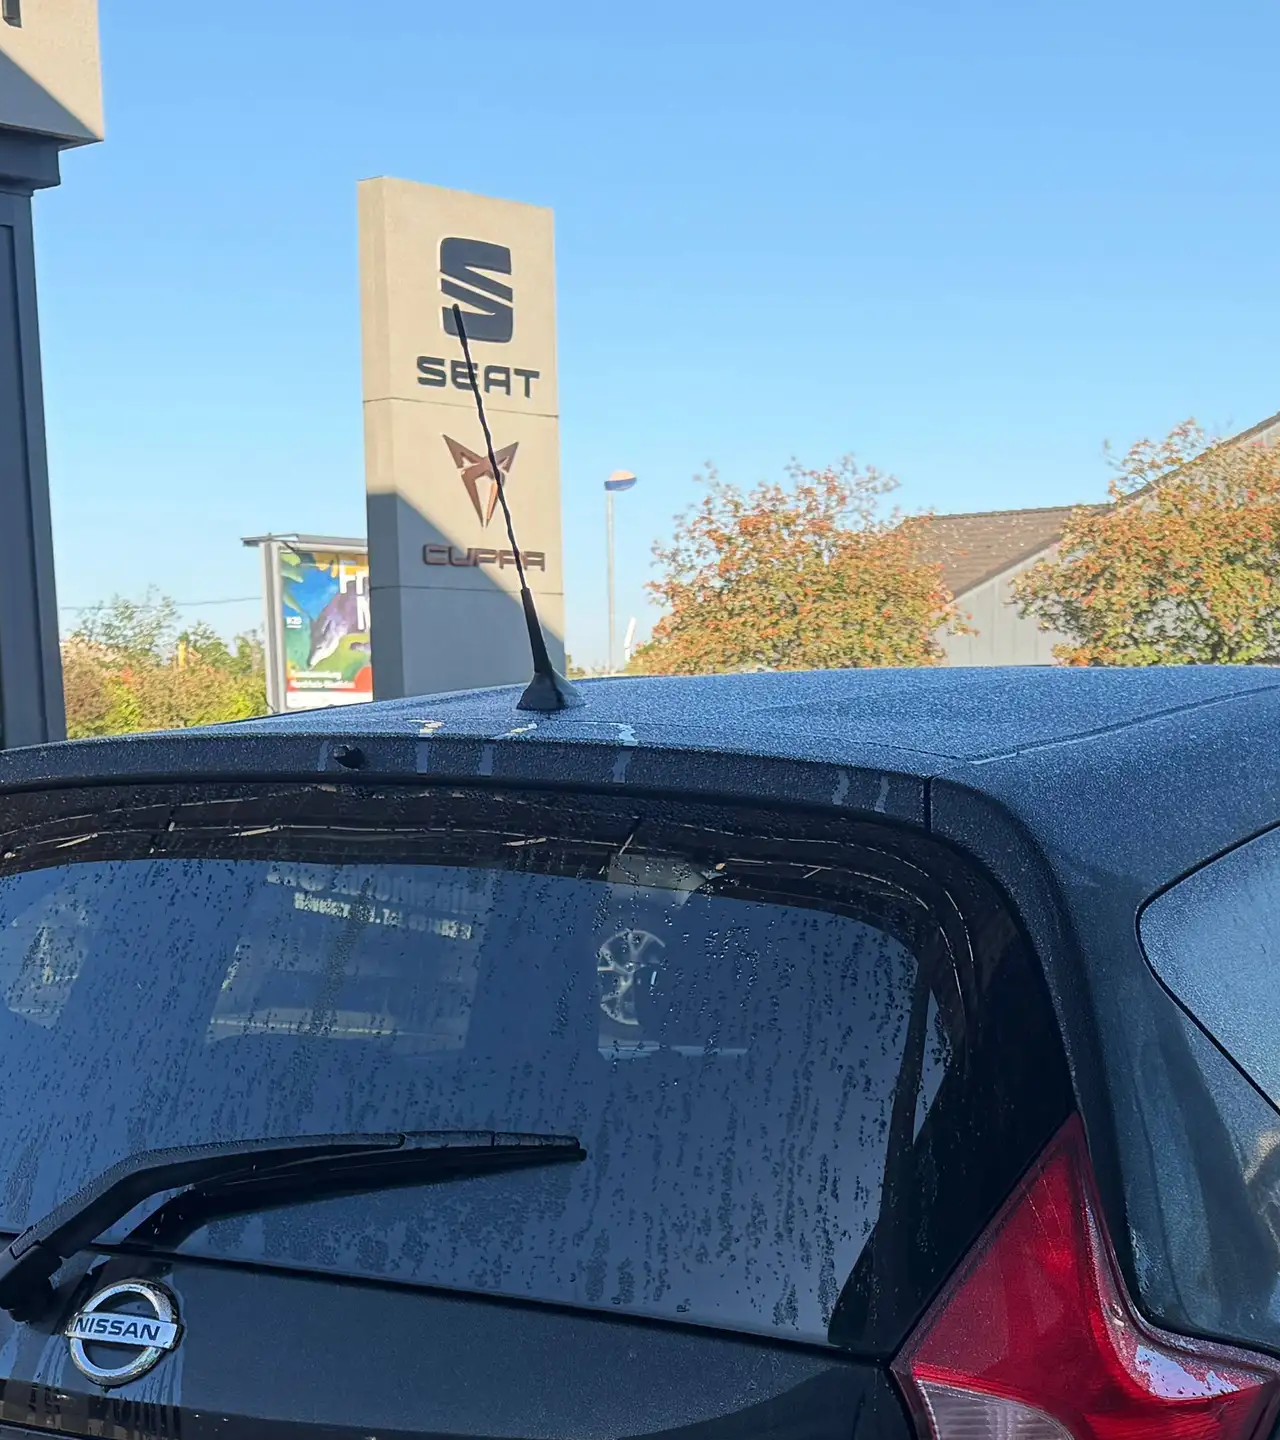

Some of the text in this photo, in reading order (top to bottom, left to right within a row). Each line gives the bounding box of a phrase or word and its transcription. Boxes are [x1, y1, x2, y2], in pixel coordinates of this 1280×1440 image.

[417, 356, 540, 398] SEAT
[422, 544, 545, 572] CUPRA
[74, 1317, 161, 1341] NISSAN
